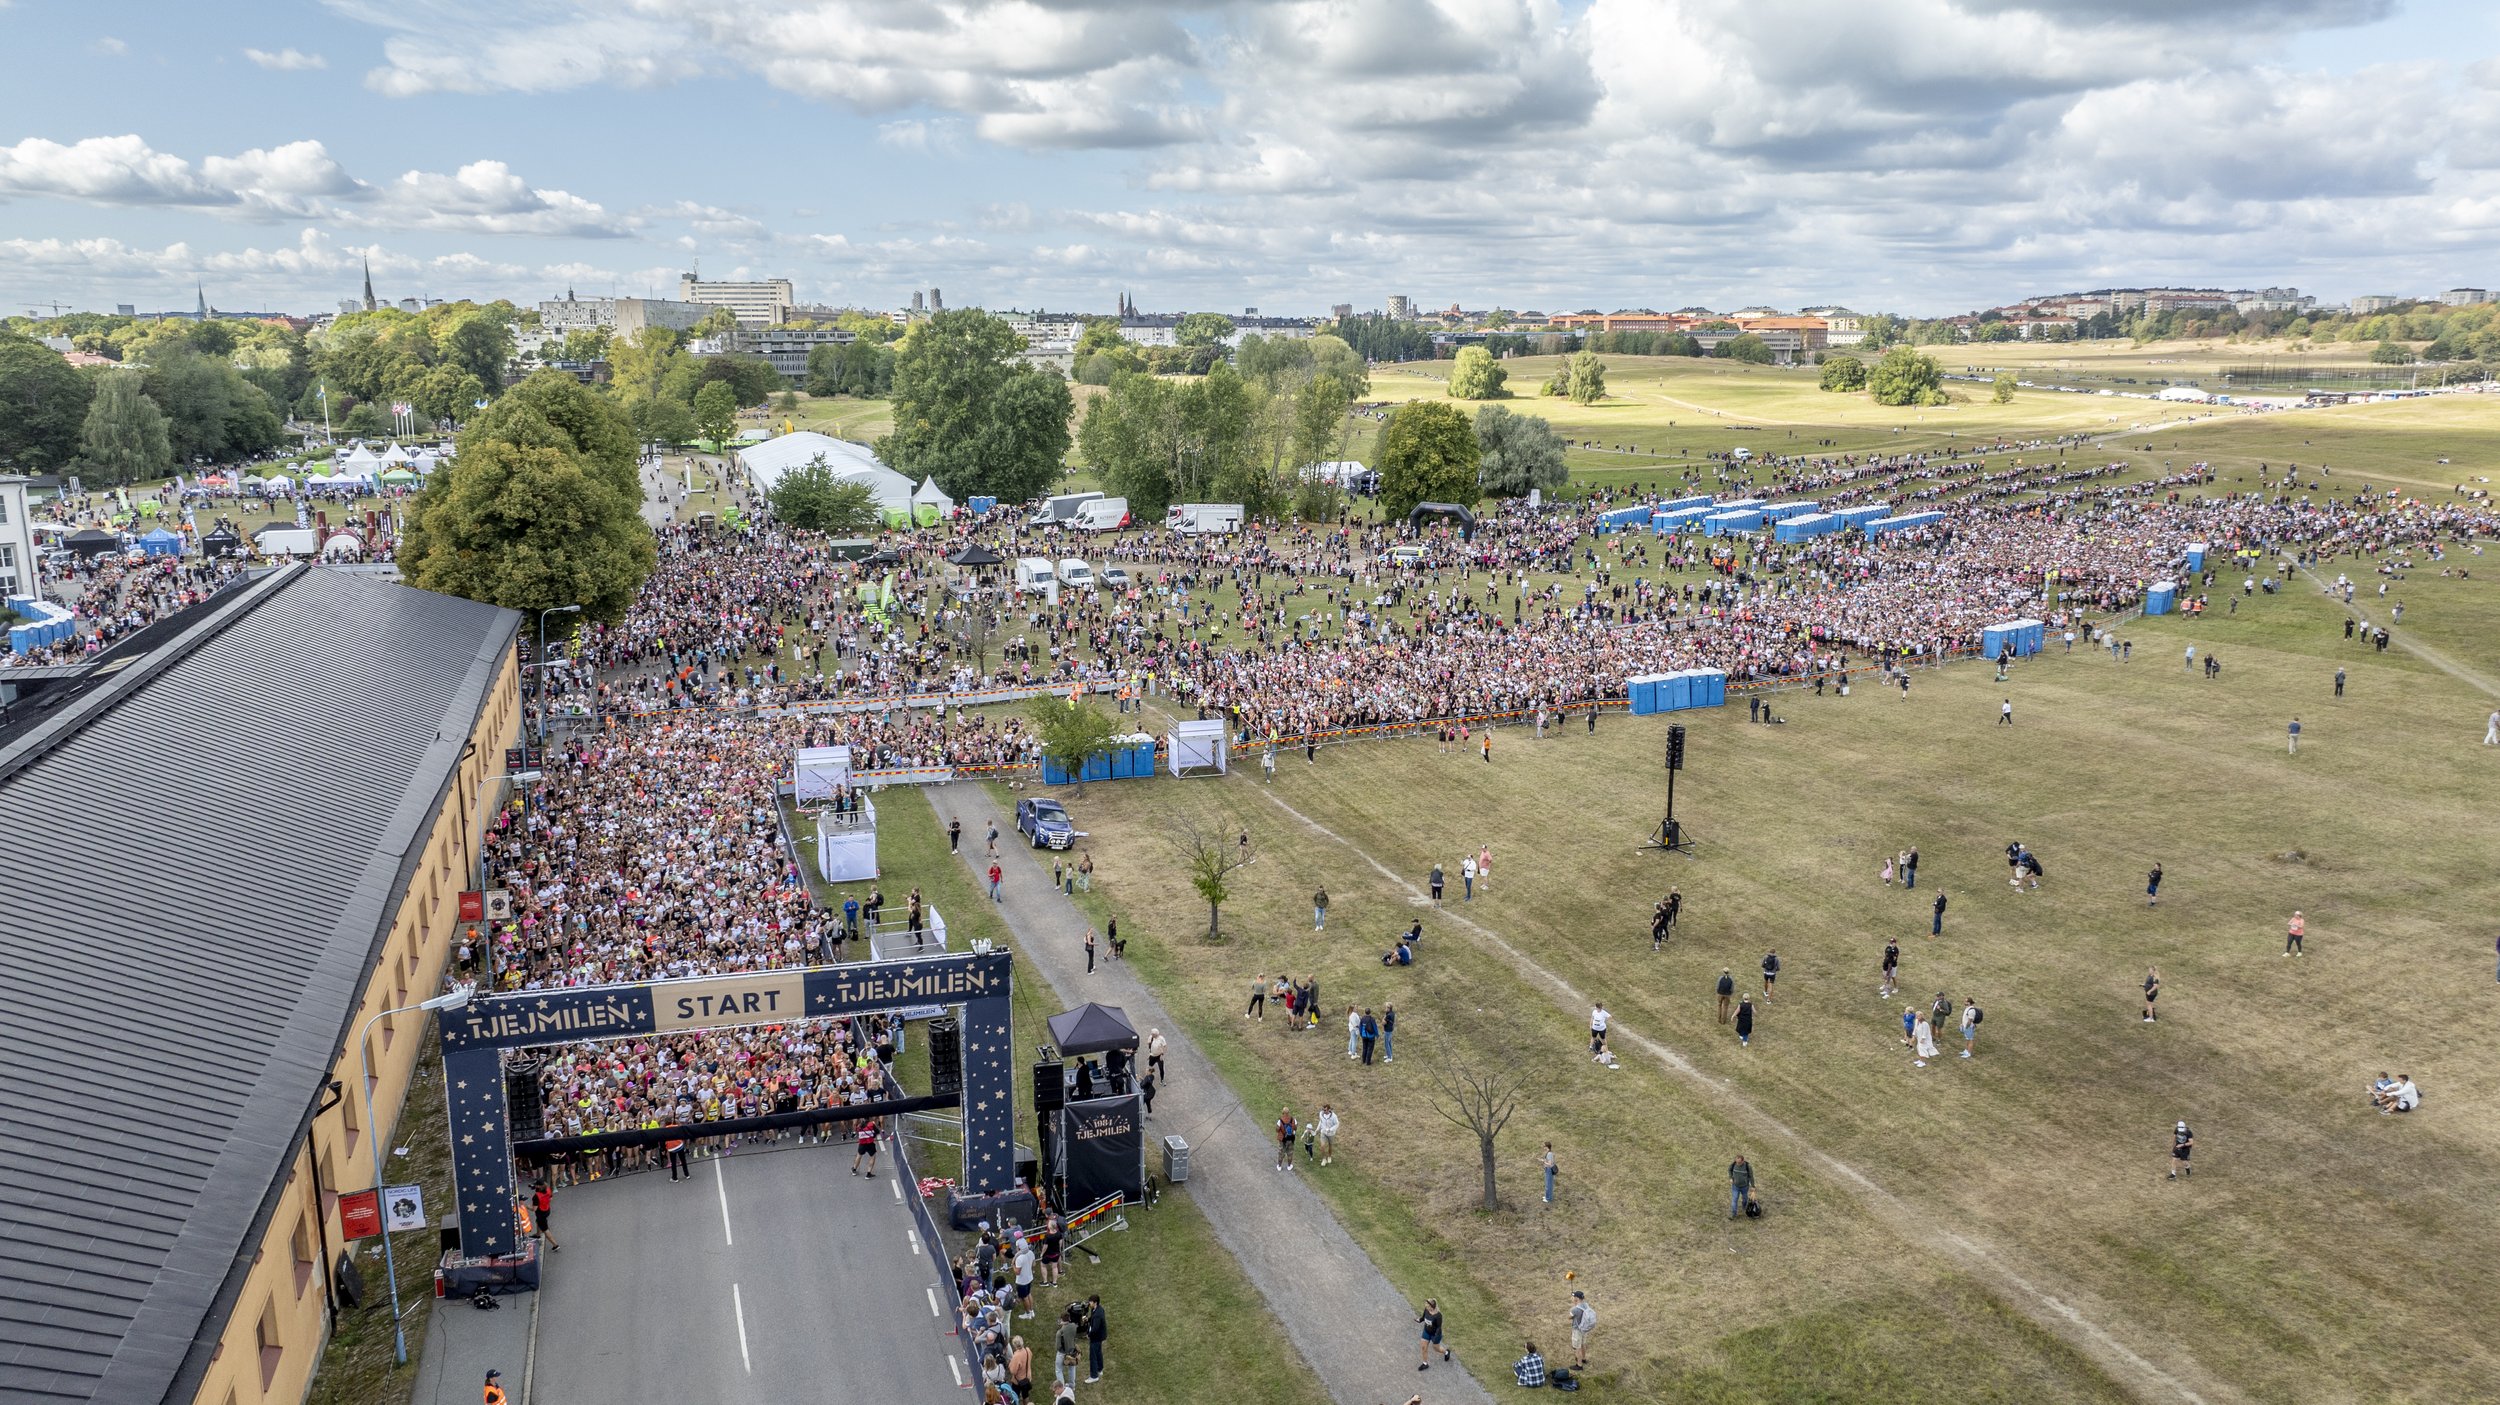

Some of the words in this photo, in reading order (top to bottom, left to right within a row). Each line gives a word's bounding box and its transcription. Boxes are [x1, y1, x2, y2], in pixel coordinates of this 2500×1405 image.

[883, 749, 891, 760] 2
[837, 970, 984, 1003] TJEJMILEN
[677, 990, 781, 1019] START
[466, 1003, 630, 1039] TJEJMILEN
[1076, 1125, 1130, 1139] TJEJMILEN
